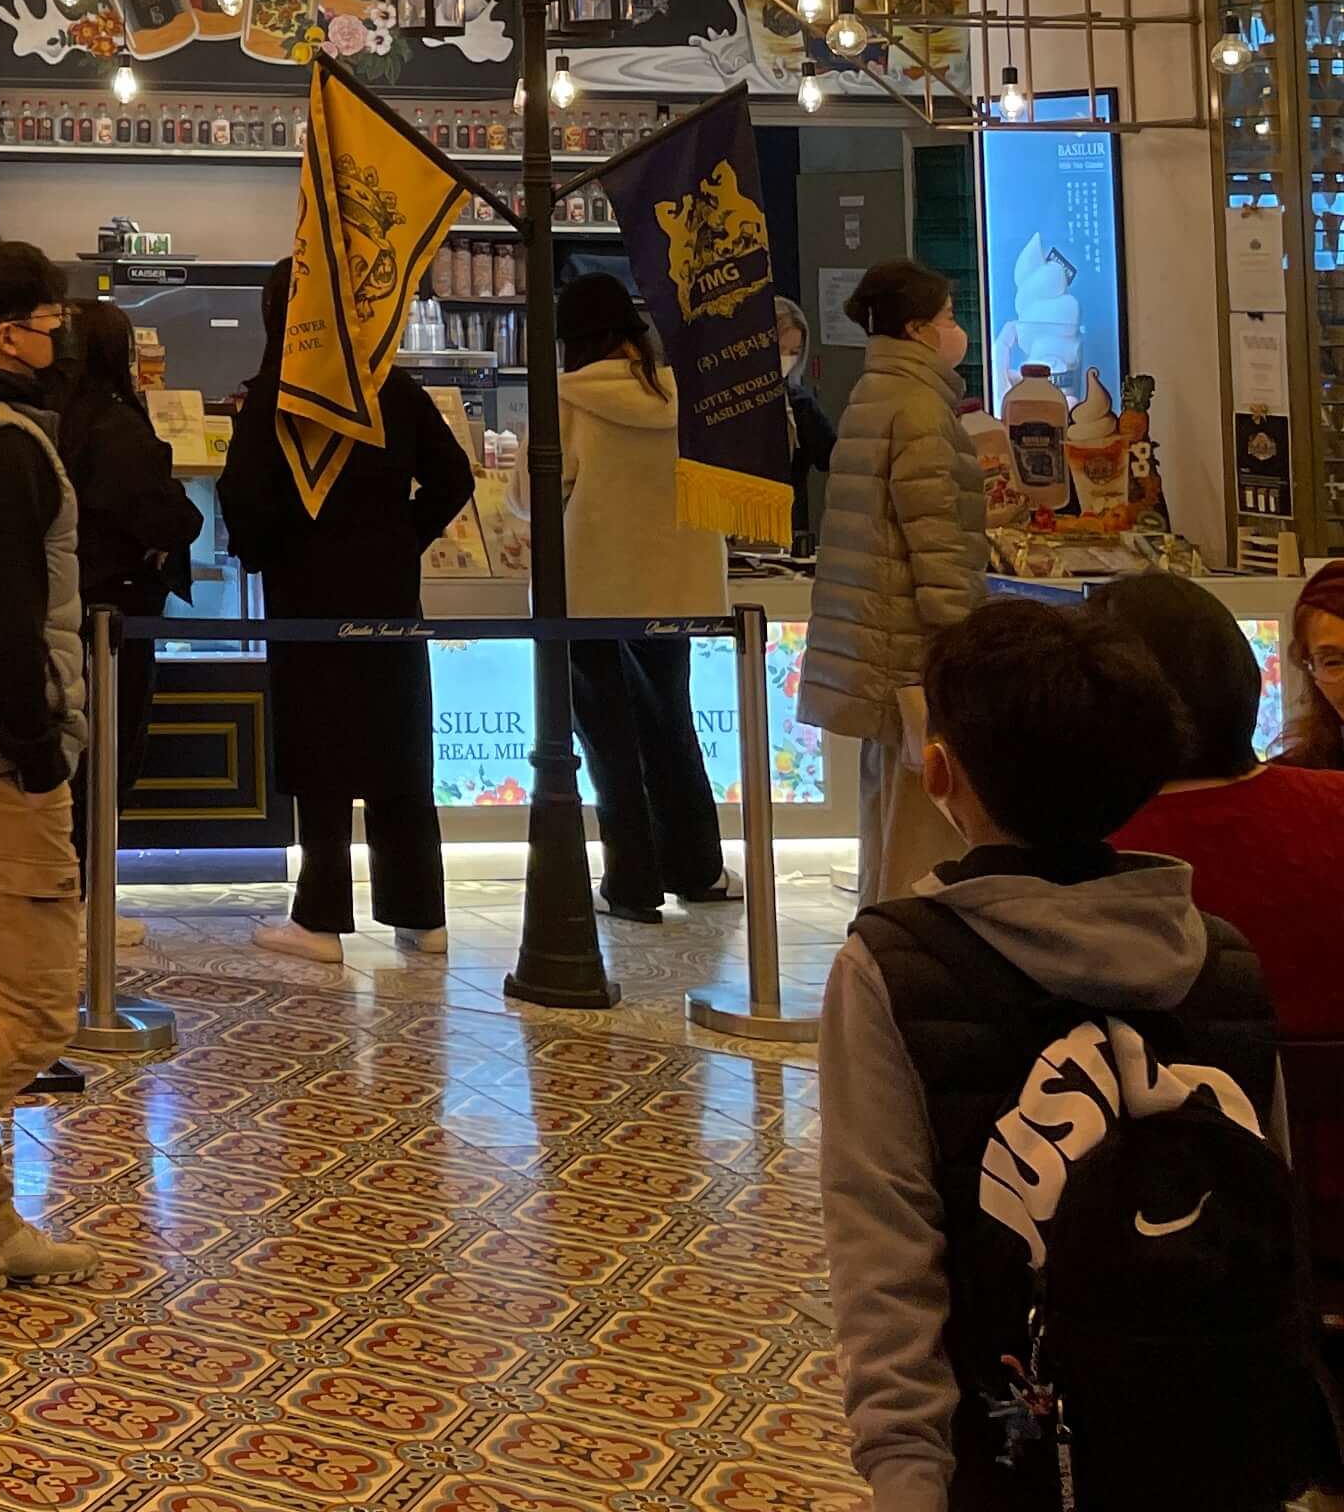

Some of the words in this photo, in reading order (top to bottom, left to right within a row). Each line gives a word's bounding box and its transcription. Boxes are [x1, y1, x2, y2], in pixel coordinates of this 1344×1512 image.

[1057, 142, 1105, 157] BASILUR
[697, 263, 741, 294] TMG
[693, 389, 733, 414] LOTTE
[733, 370, 779, 397] WORLD
[705, 398, 755, 427] BASILUR
[432, 711, 526, 735] SILUR
[438, 743, 490, 761] REAL
[494, 743, 529, 761] MIL
[979, 1020, 1121, 1272] JUST
